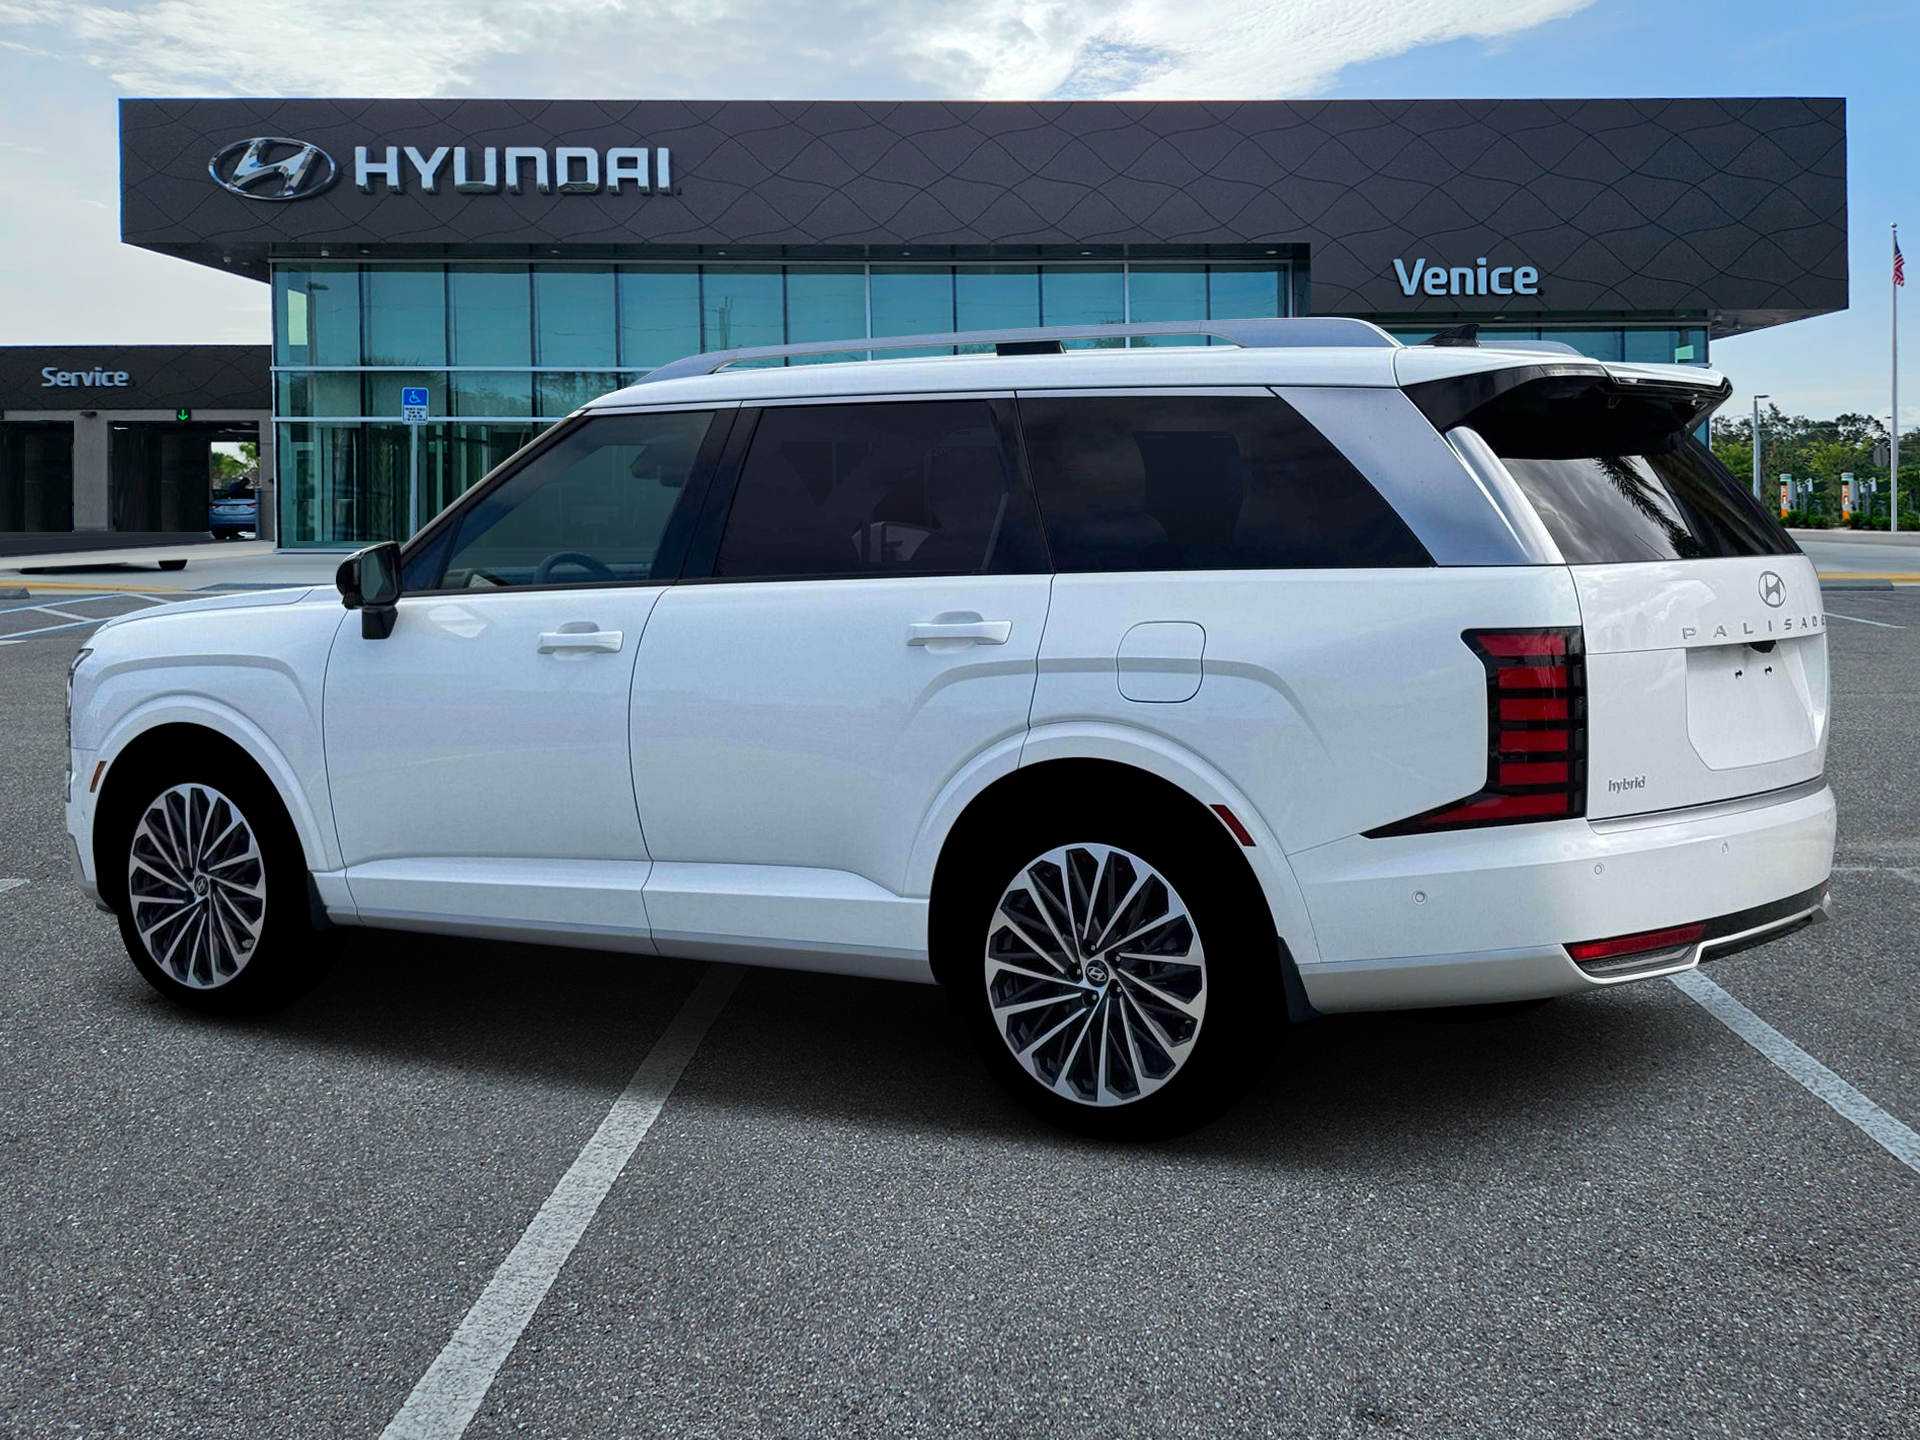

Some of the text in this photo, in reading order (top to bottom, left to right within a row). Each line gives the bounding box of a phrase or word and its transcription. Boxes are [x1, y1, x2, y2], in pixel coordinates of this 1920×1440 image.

[354, 146, 672, 193] HYUNDAI
[1392, 256, 1540, 296] Venice
[41, 366, 130, 387] Service
[1682, 614, 1826, 640] PALISADE
[1608, 775, 1646, 795] hybrid
